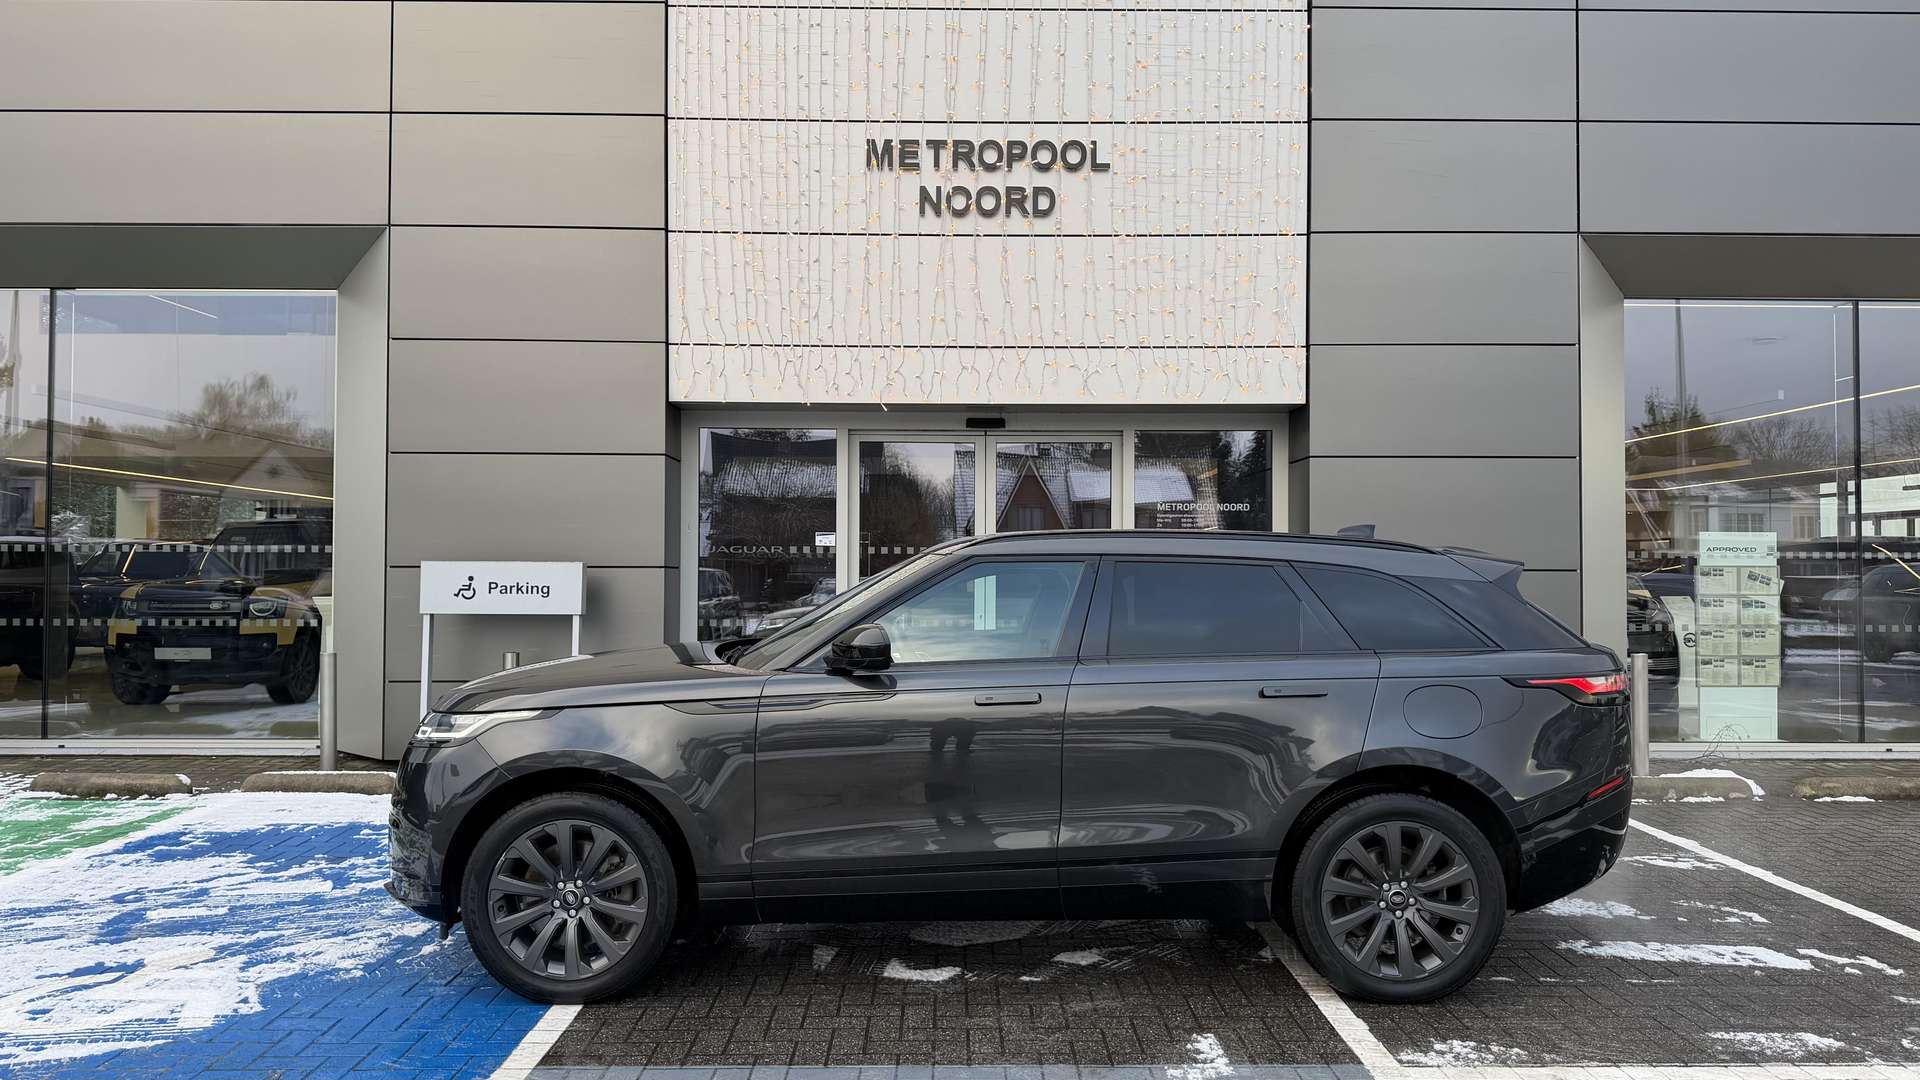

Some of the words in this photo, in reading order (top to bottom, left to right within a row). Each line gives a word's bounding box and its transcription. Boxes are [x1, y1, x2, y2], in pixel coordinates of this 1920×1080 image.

[865, 138, 1111, 172] METROPOOL
[918, 185, 1057, 218] NOORD
[1157, 503, 1214, 511] METROPOOL
[1216, 503, 1250, 511] NOORD
[709, 545, 784, 554] JAGUAR
[487, 581, 551, 598] Parking
